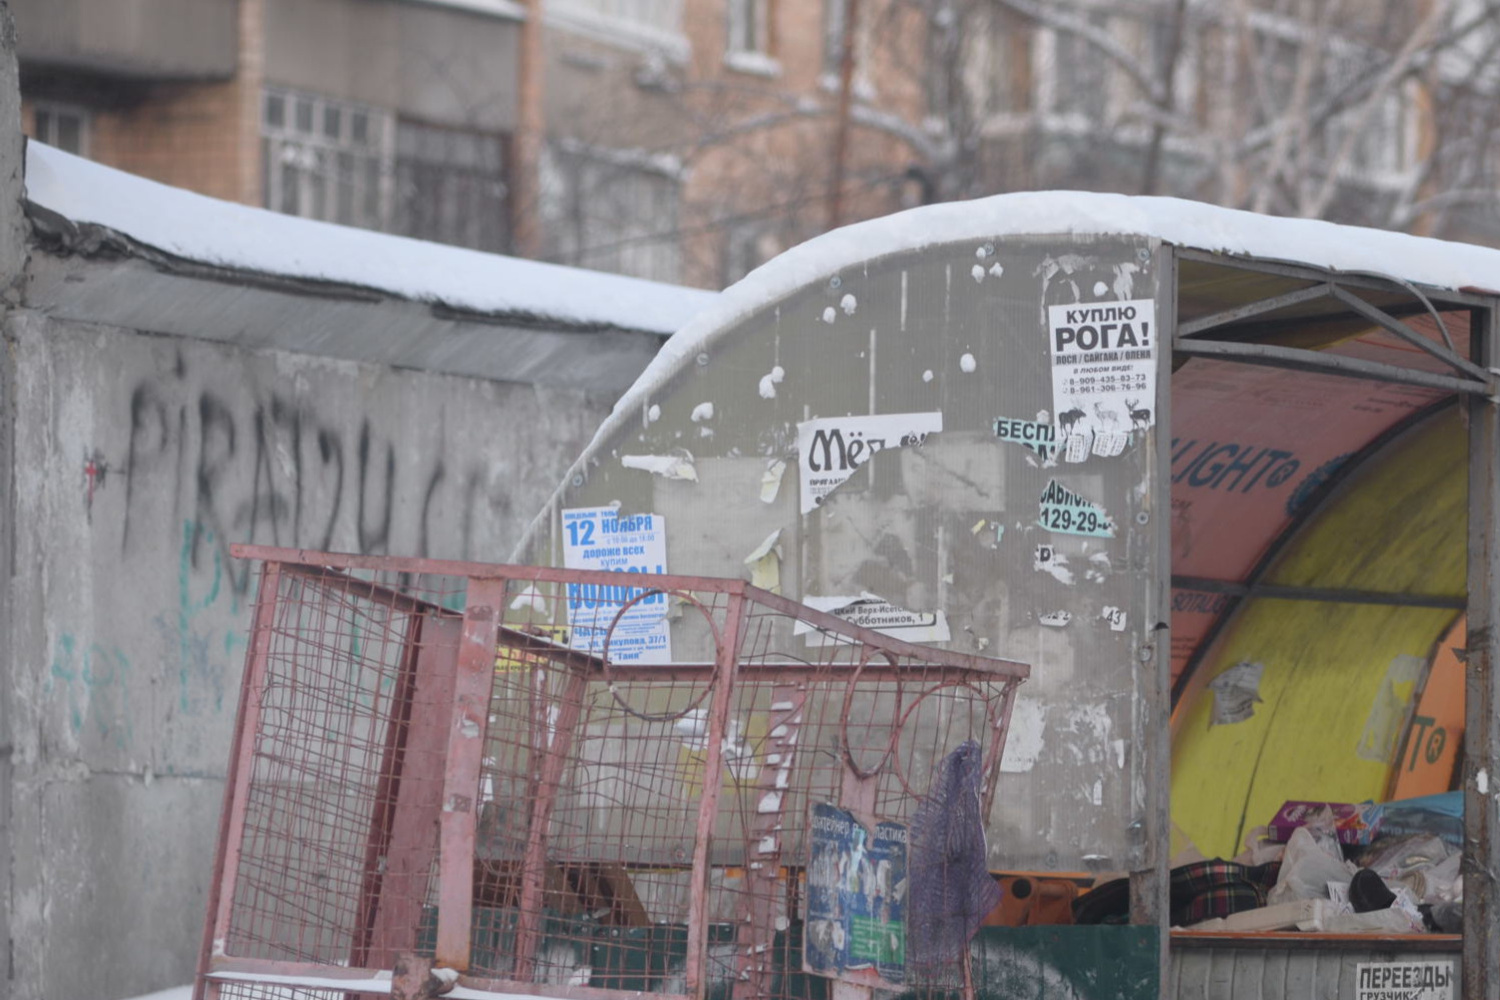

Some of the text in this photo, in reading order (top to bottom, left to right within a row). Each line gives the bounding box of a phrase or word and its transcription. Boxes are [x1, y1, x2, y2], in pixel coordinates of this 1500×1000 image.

[1066, 306, 1137, 324] КУПЛЮ
[1055, 322, 1150, 352] РОГА!
[565, 515, 653, 547] 12 НОЯБРЯ
[582, 545, 645, 559] дороже всех
[600, 558, 628, 568] купим
[1360, 966, 1449, 991] ПЕРЕЕЗДЫ
